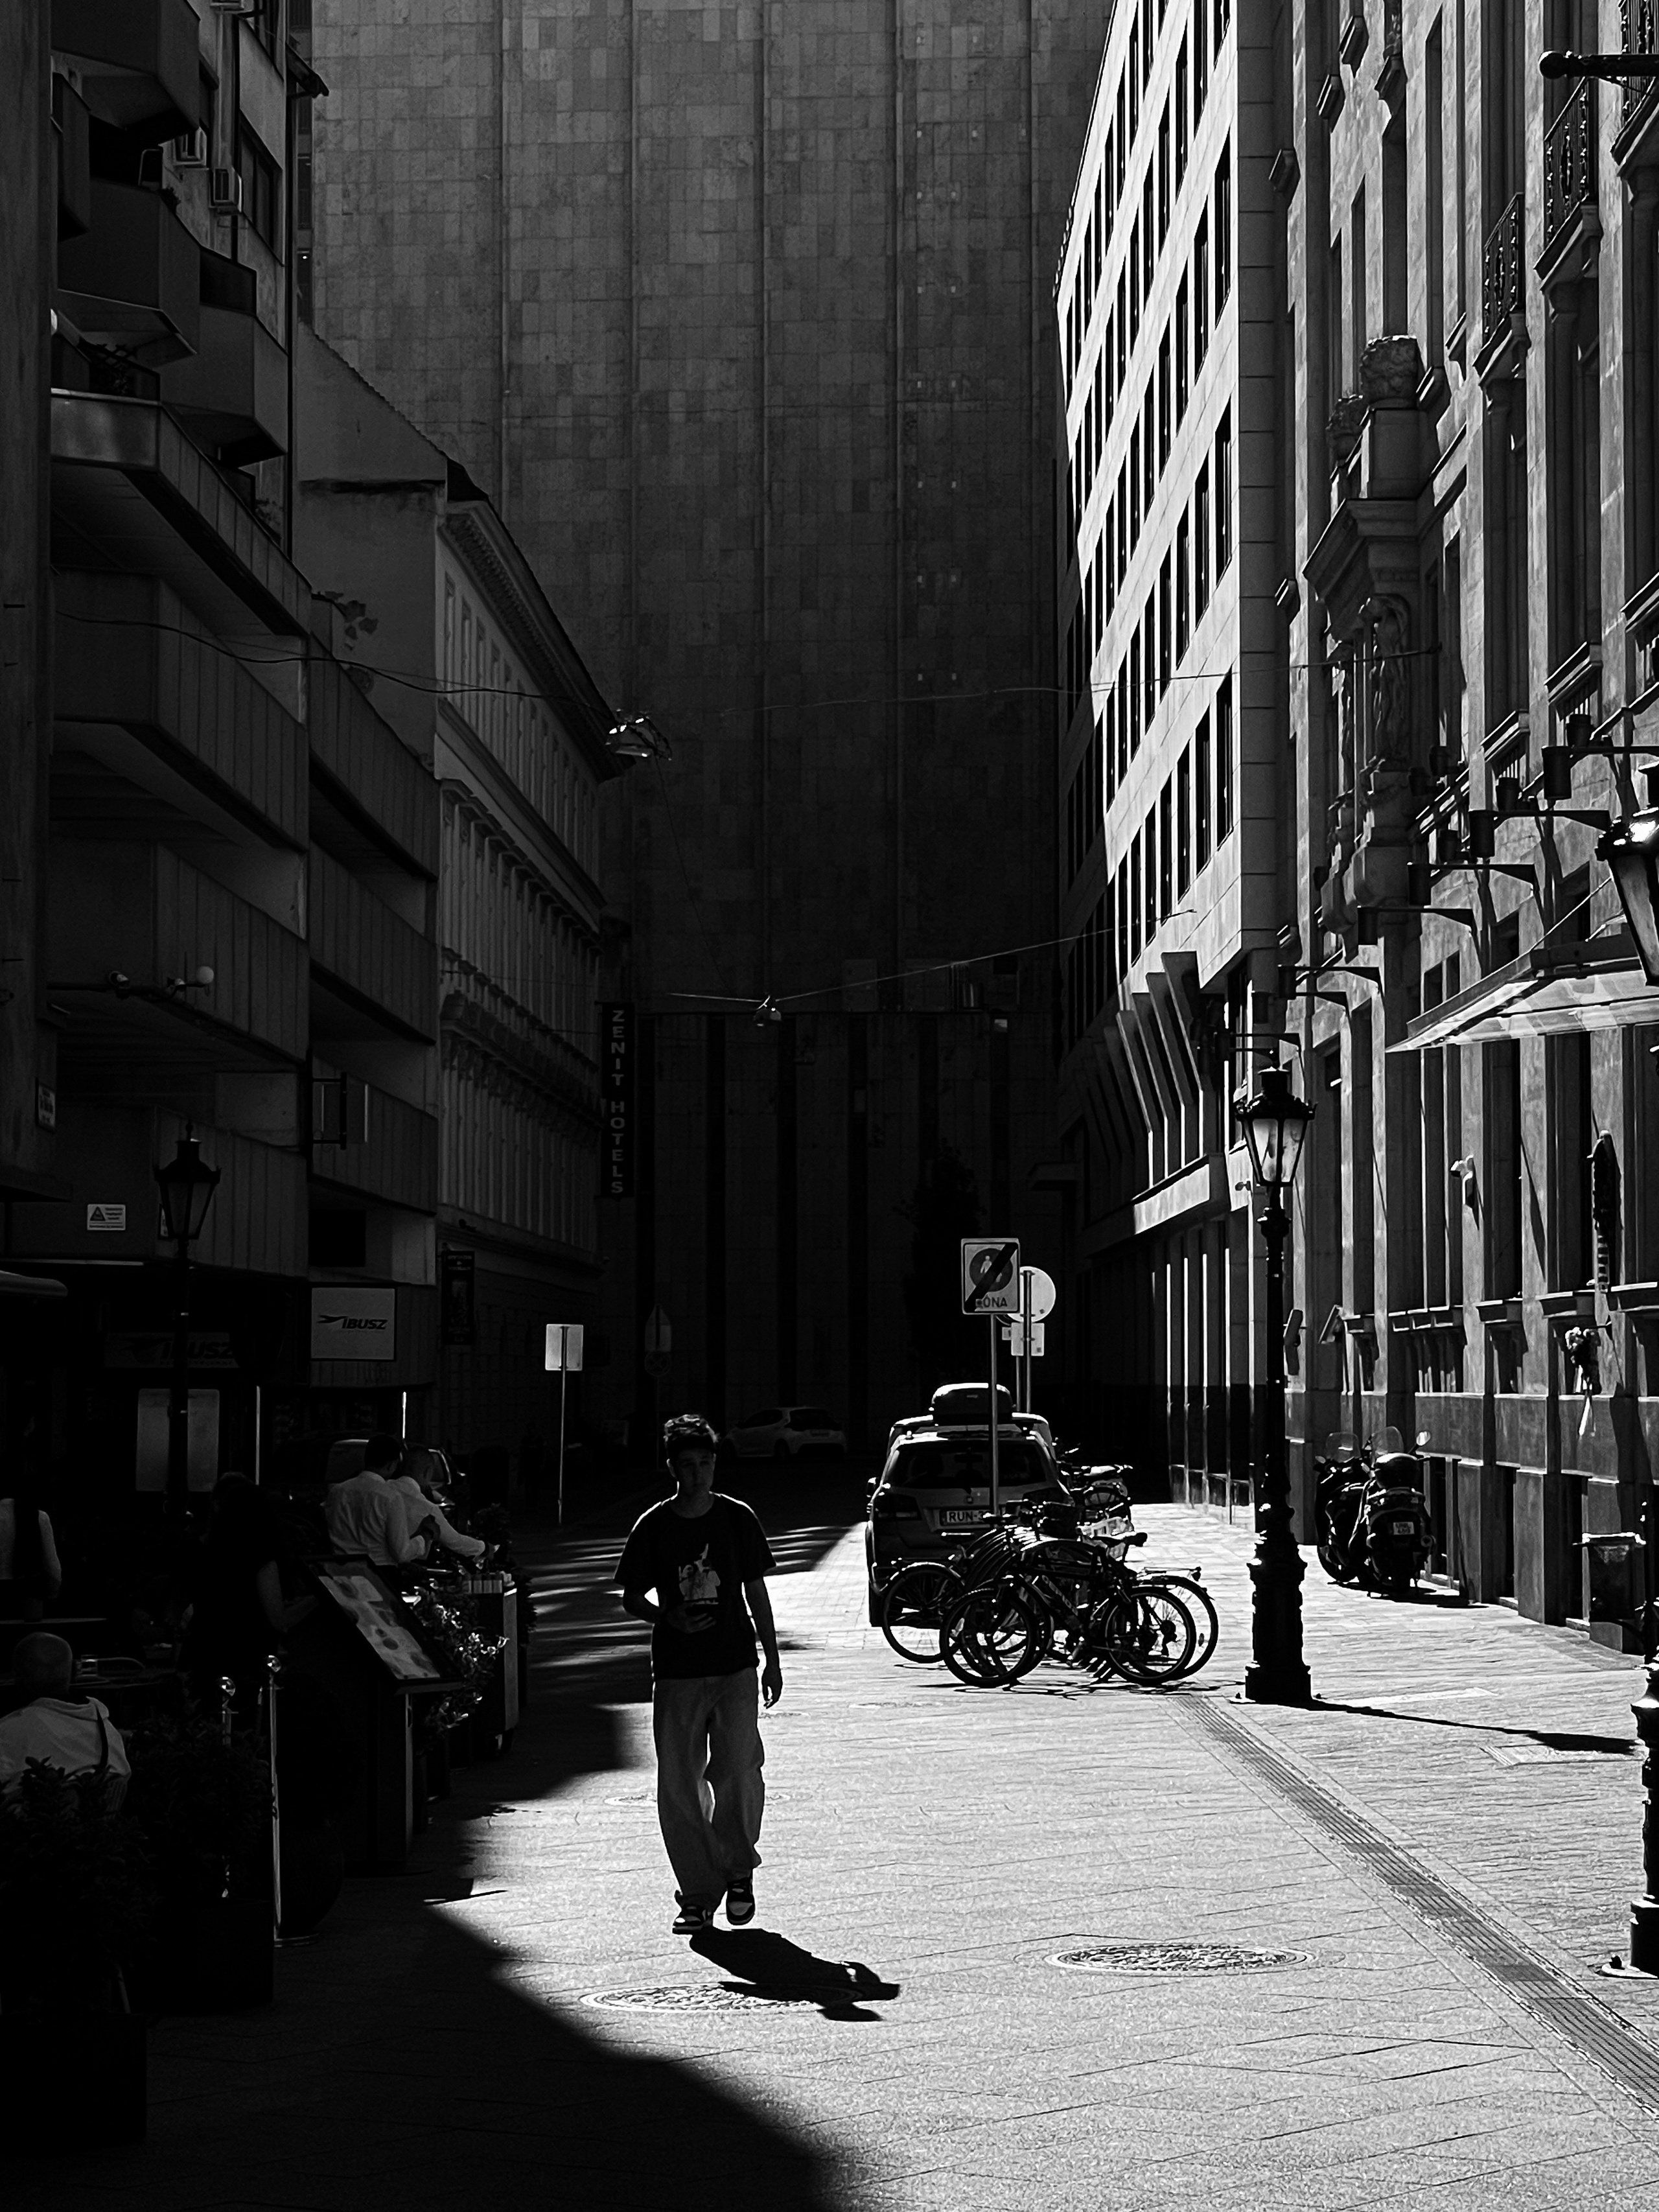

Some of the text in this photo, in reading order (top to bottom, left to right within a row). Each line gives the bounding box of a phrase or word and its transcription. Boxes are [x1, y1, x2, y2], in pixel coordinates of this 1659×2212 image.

[610, 1009, 626, 1194] ZENIT HOTELS
[975, 1294, 1008, 1309] ÓNA
[342, 1318, 388, 1330] IBUSZ
[161, 1340, 233, 1359] IUSZ
